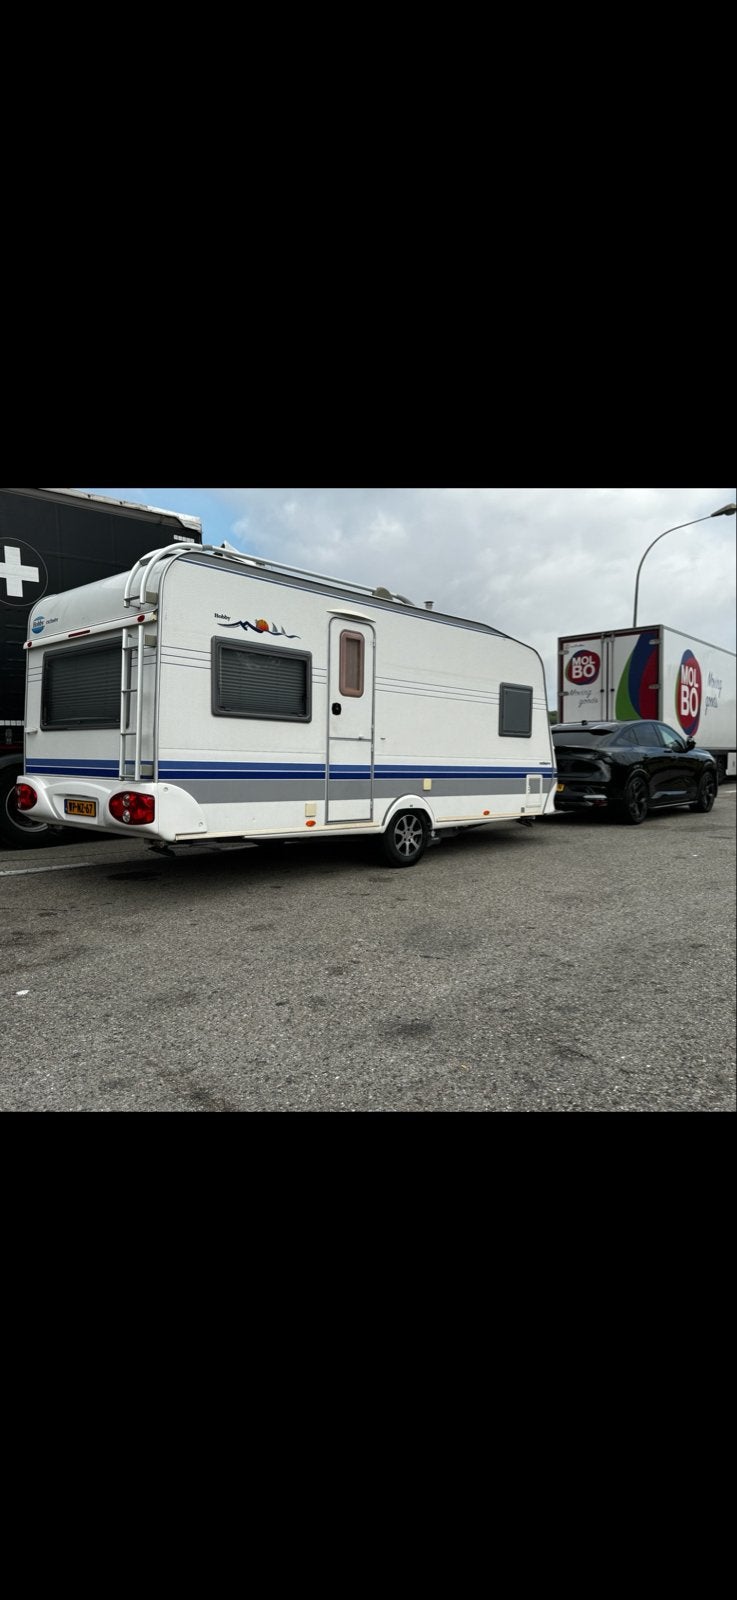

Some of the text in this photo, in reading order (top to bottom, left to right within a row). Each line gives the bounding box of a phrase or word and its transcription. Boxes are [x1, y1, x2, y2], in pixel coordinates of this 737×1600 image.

[214, 613, 231, 622] Hobby
[572, 656, 596, 665] MOL
[572, 664, 596, 679] BO
[681, 664, 699, 688] MOL
[681, 684, 699, 718] BO
